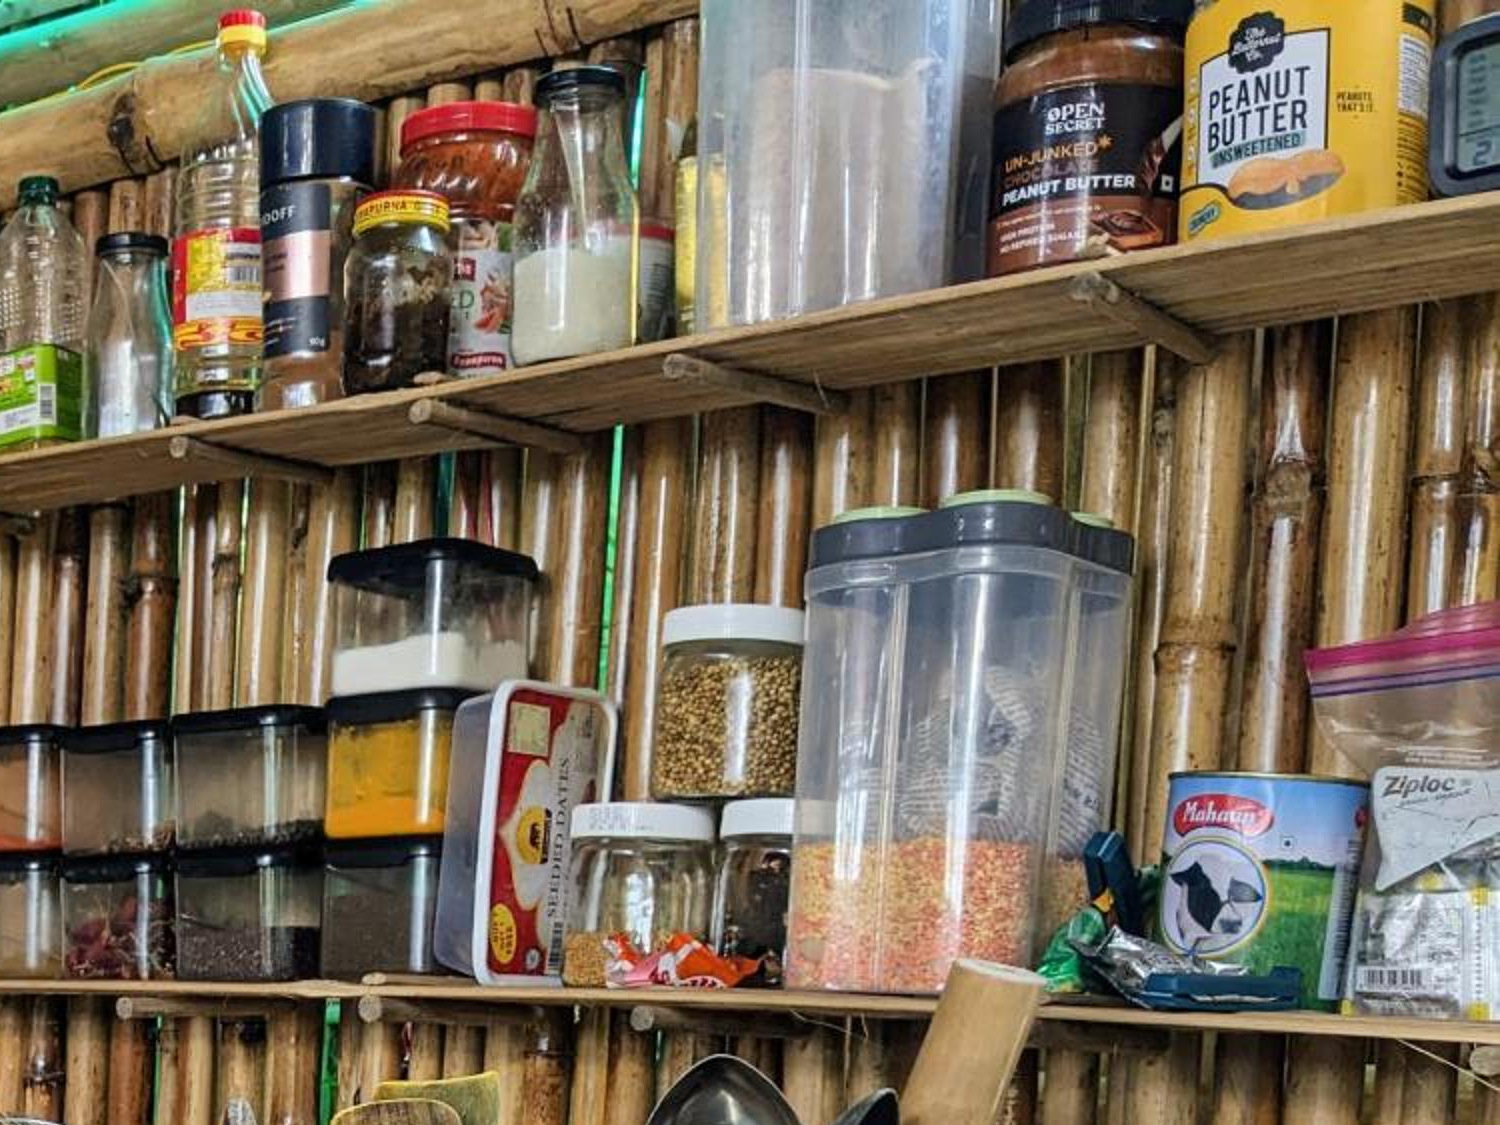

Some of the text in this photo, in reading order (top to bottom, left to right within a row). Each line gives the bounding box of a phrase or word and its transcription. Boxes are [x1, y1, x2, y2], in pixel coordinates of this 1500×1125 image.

[1209, 66, 1311, 120] PEANUT
[1045, 117, 1106, 136] SECRET
[1047, 103, 1106, 122] OPEN
[1208, 99, 1308, 153] BUTTER
[1002, 174, 1135, 206] PEANUT BUTTER
[555, 757, 569, 826] DATES
[1382, 775, 1455, 799] Ziploc
